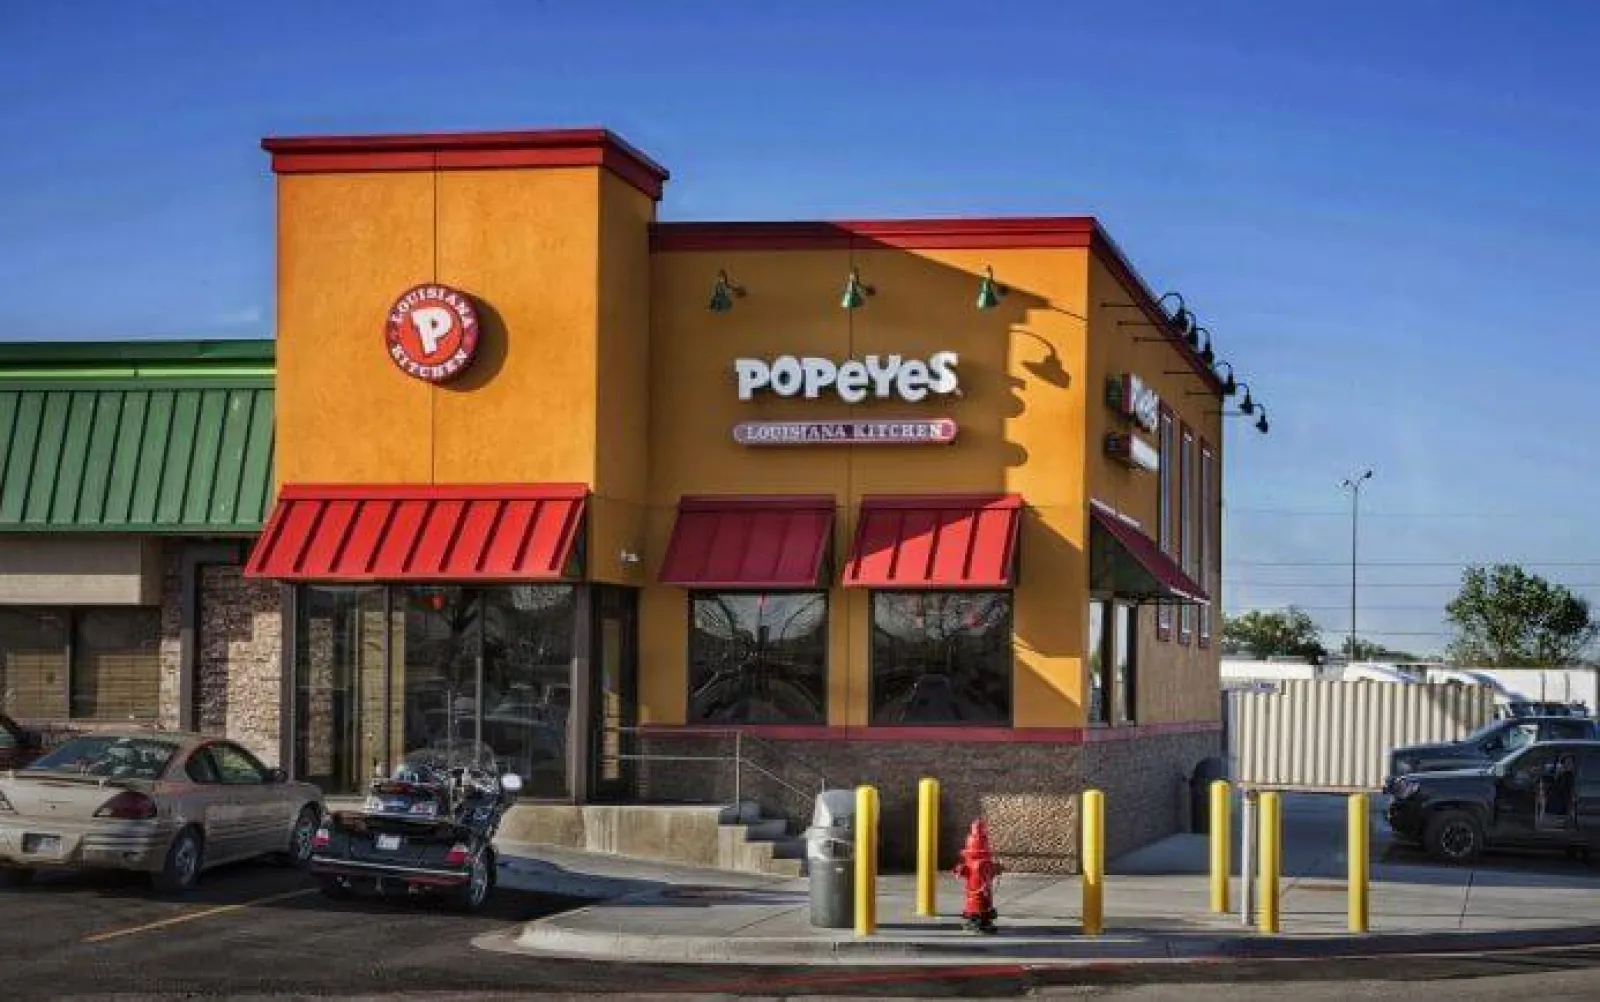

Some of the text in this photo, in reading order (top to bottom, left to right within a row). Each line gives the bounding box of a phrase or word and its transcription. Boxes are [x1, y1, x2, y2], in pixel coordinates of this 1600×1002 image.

[390, 287, 474, 327] LOUISIANA
[411, 307, 453, 354] P
[391, 343, 467, 377] KITCHEN
[747, 423, 943, 440] LOUISIANA KITCHEN
